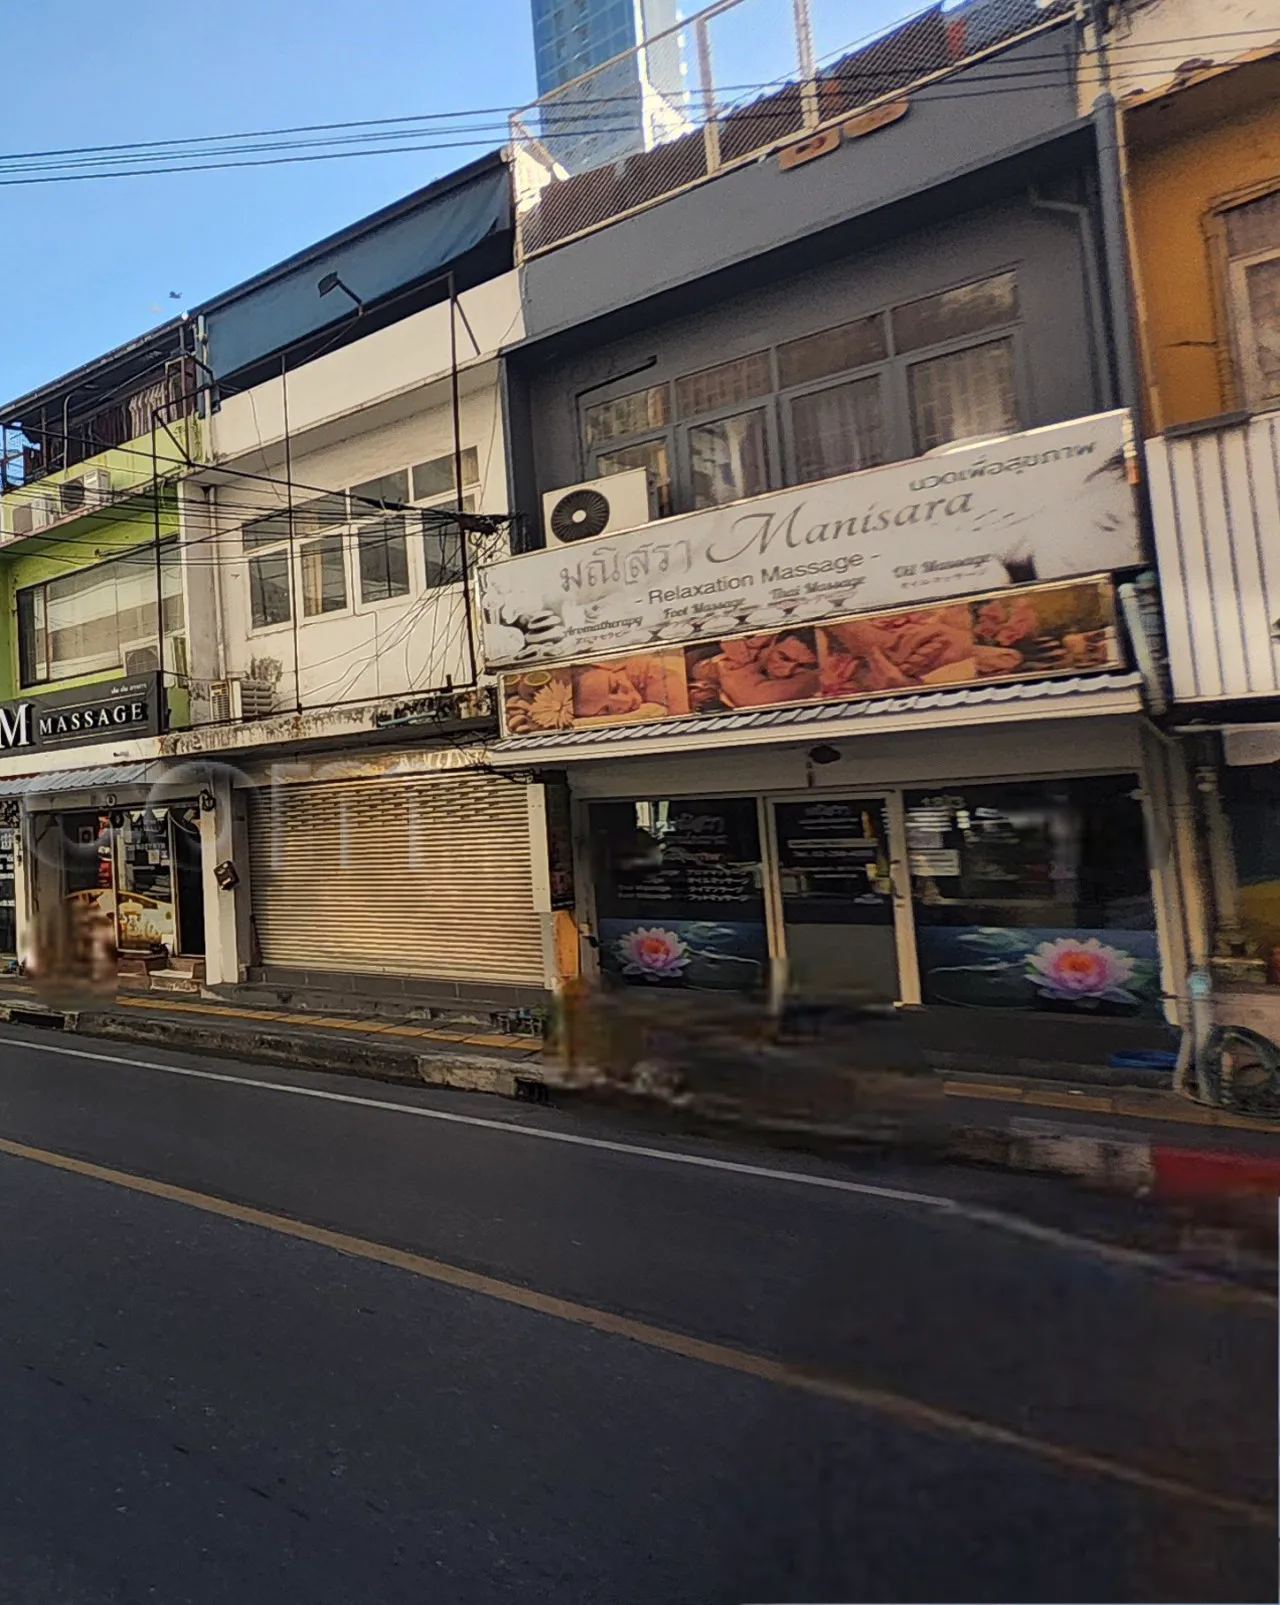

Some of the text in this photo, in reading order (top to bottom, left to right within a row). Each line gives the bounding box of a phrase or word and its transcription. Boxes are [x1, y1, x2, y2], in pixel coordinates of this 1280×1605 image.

[705, 491, 975, 565] Manisara
[647, 552, 864, 606] Relaxation Massage
[37, 701, 145, 738] MASSAGE
